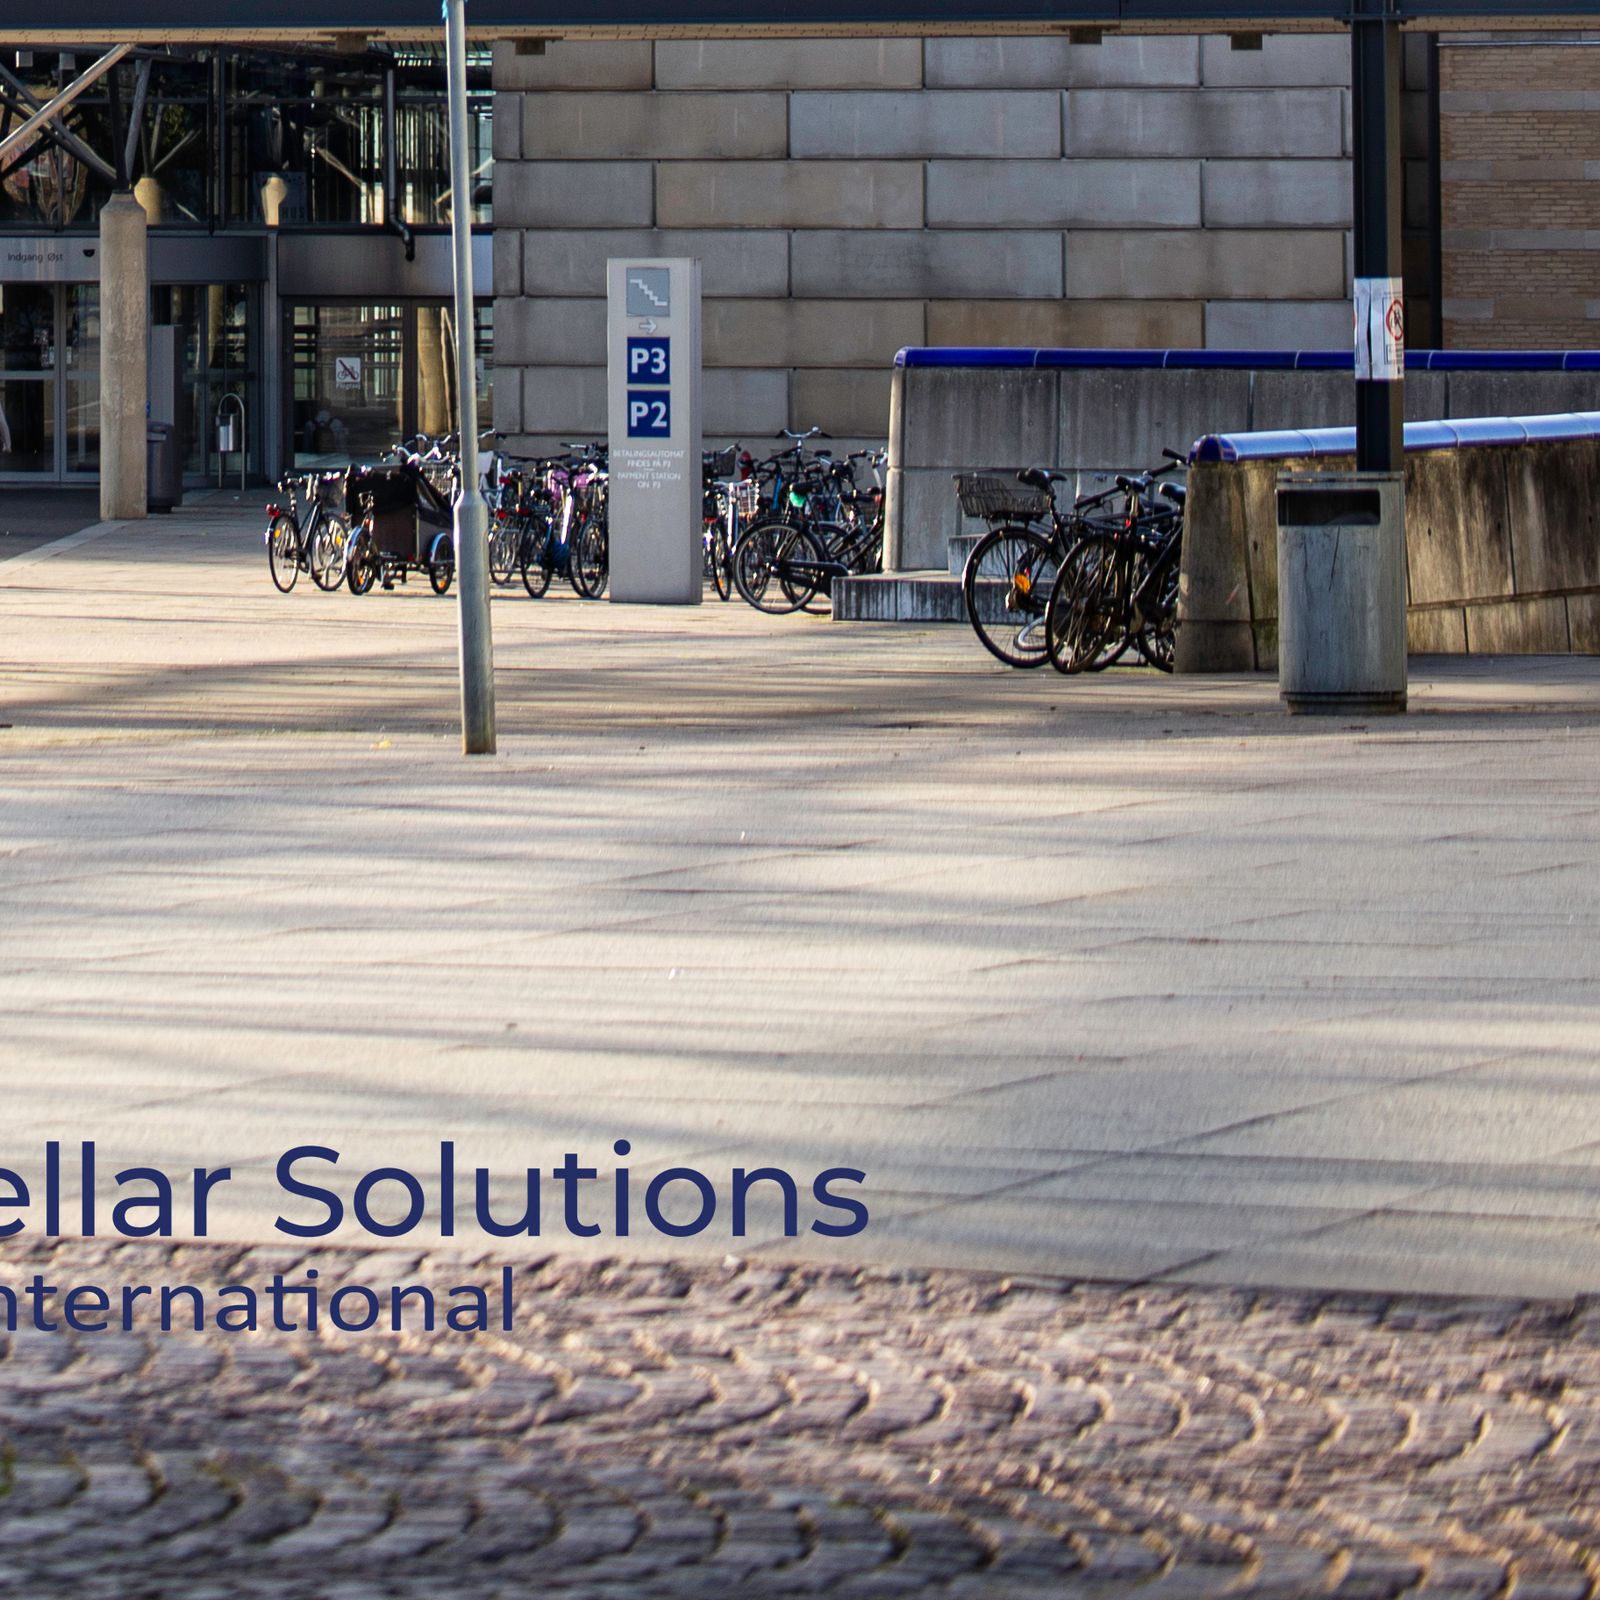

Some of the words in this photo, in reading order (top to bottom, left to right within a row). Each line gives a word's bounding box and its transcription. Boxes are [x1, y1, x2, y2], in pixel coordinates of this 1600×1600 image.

[7, 252, 43, 264] Indgang
[47, 252, 64, 262] Øst
[631, 347, 667, 374] P3
[630, 401, 668, 428] P2
[617, 472, 649, 480] PAYMENT
[651, 472, 681, 480] STATION
